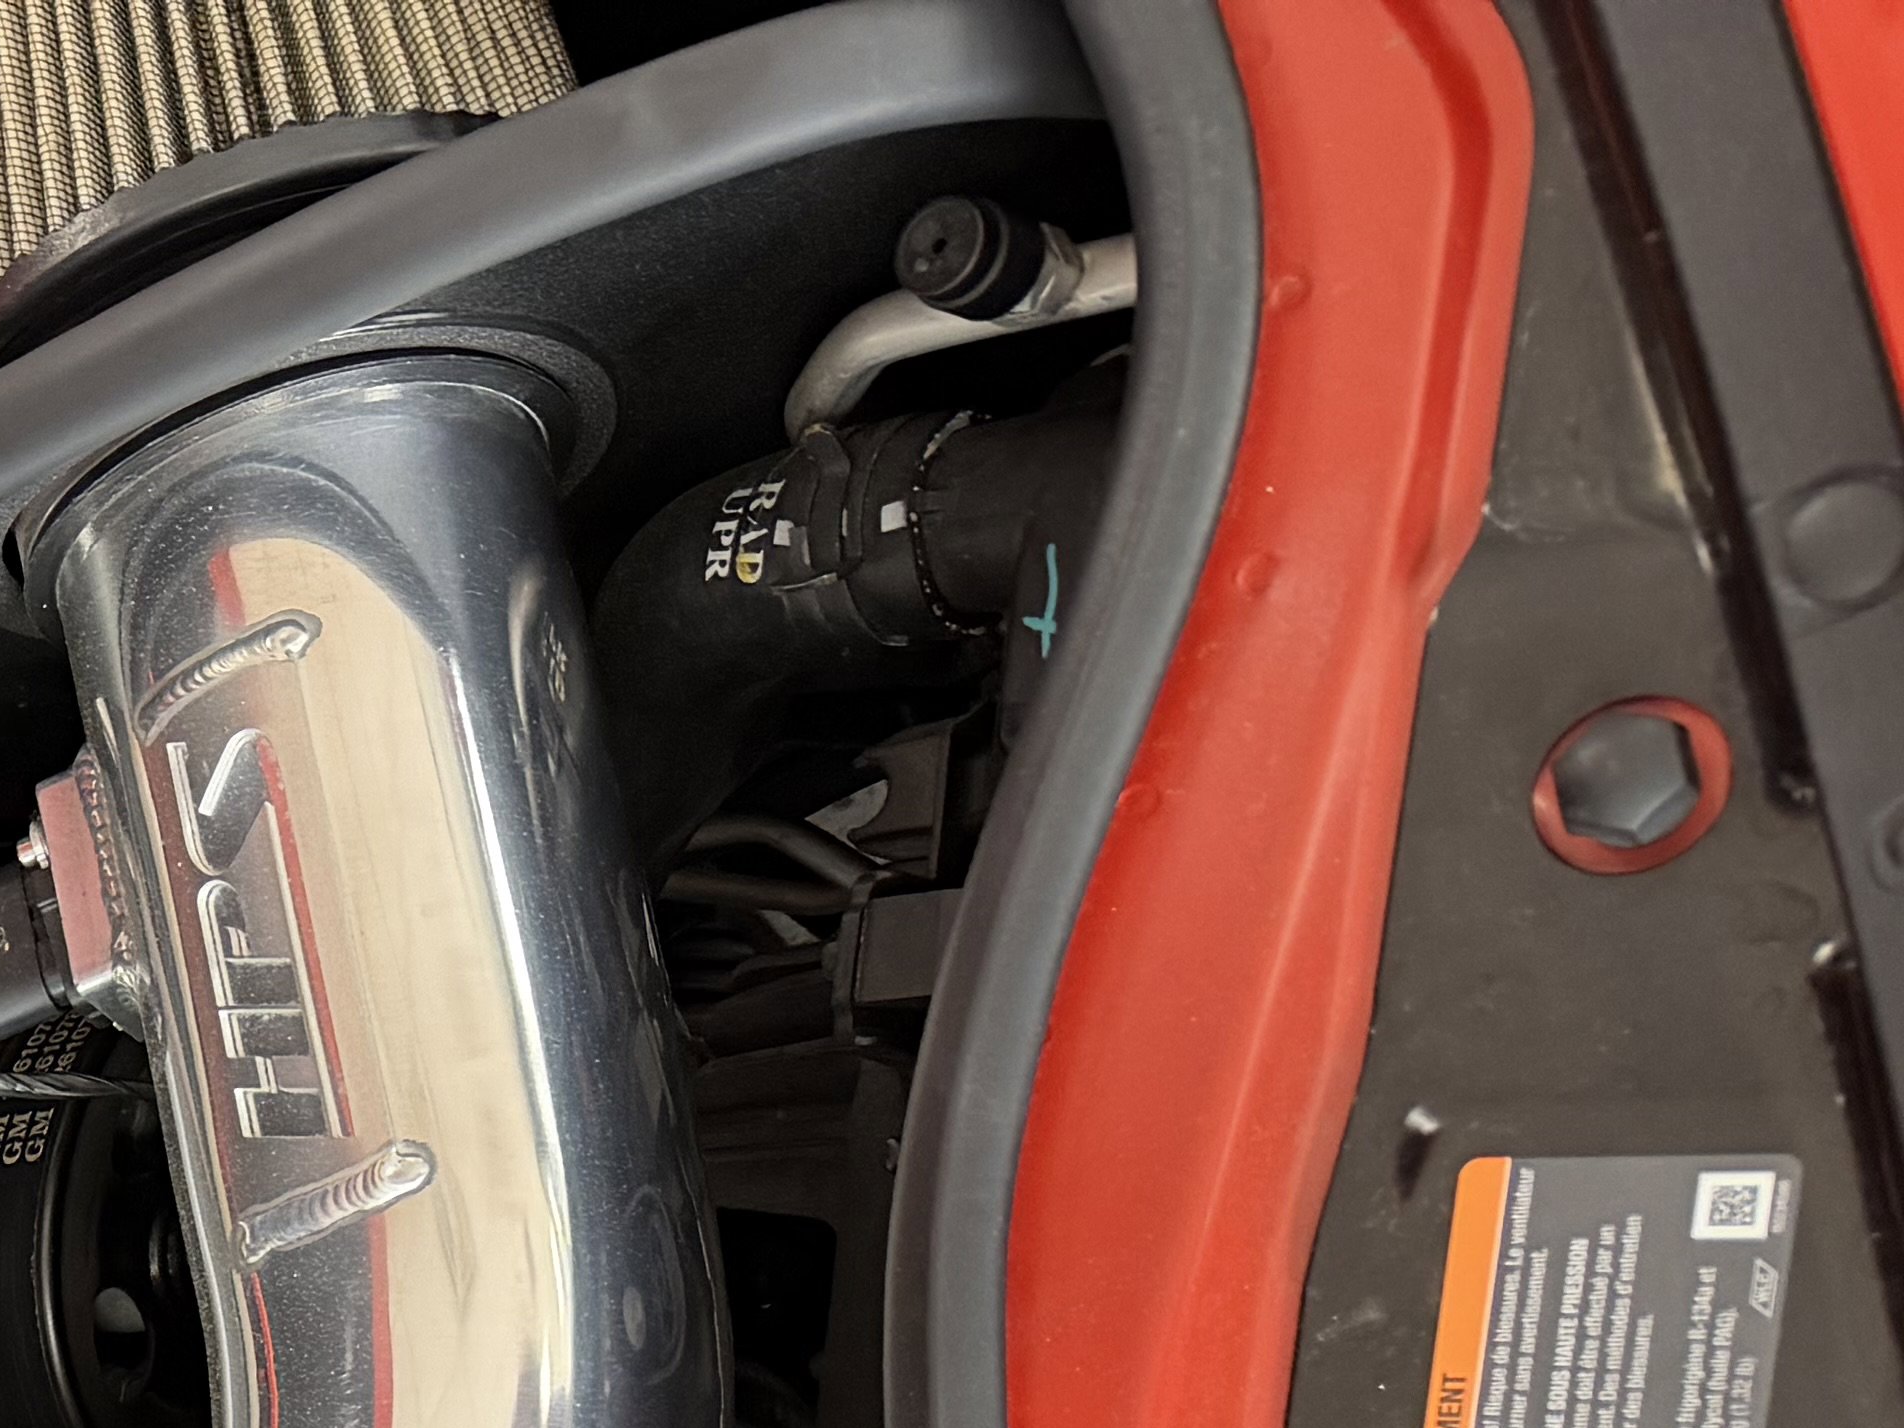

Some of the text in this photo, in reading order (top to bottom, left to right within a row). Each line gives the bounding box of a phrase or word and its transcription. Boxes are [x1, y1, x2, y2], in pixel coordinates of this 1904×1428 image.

[704, 487, 752, 582] UPR
[735, 480, 787, 584] RAD
[3, 1111, 31, 1164] GM
[26, 1108, 53, 1162] GM
[1510, 1167, 1534, 1245] ventilateur
[1503, 1247, 1524, 1265] Le
[1599, 1224, 1615, 1245] un
[1560, 1238, 1589, 1314] PRESSION
[1594, 1248, 1613, 1273] par
[1583, 1276, 1609, 1336] effectué
[1490, 1344, 1511, 1364] de
[1553, 1316, 1578, 1366] HAUTE
[1577, 1338, 1600, 1368] être
[1605, 1297, 1631, 1370] méthodes
[1482, 1366, 1507, 1416] Risque
[1513, 1355, 1534, 1391] sans
[1546, 1369, 1571, 1410] SOUS
[1574, 1370, 1595, 1400] doit
[1597, 1373, 1620, 1401] Des
[1621, 1391, 1643, 1419] des
